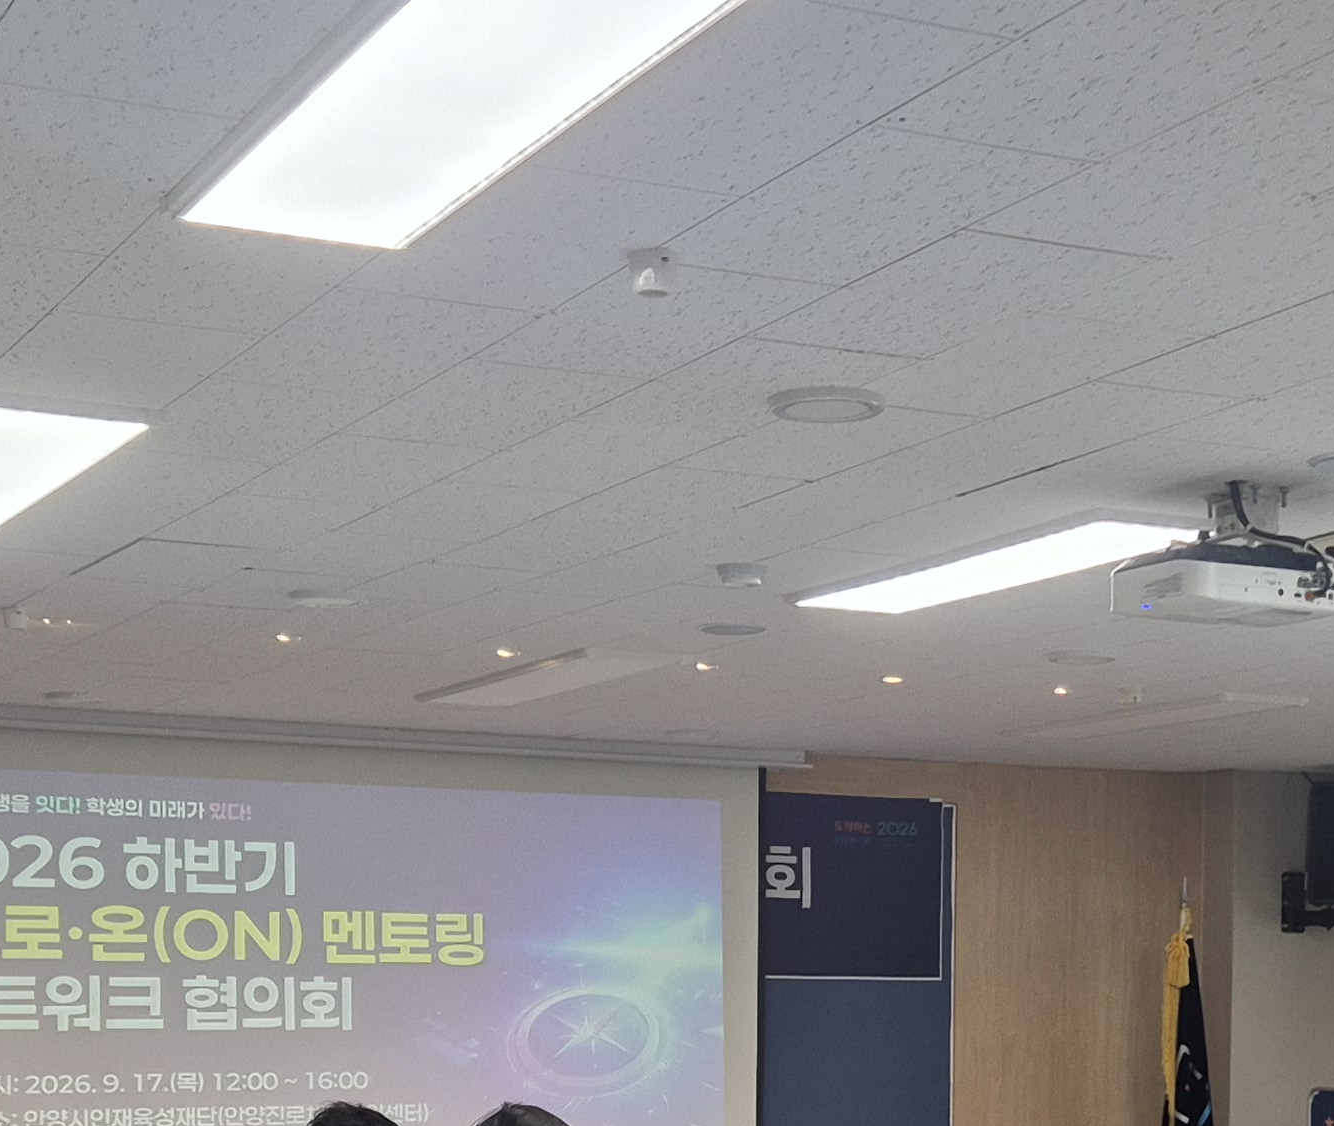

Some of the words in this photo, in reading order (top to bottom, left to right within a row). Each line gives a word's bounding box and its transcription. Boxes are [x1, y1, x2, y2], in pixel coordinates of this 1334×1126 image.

[36, 795, 81, 815] 잇다!
[86, 797, 143, 818] 학생의
[149, 799, 205, 820] 미래가
[209, 801, 253, 821] 있다!
[122, 836, 297, 896] 하반기
[322, 910, 485, 966] 멘토링
[182, 974, 354, 1032] 협의회
[25, 1074, 97, 1095] 2026.
[102, 1074, 126, 1095] 9.
[133, 1073, 205, 1095] 17.(목)
[213, 1072, 279, 1092] 12:00
[305, 1070, 369, 1091] 16:00
